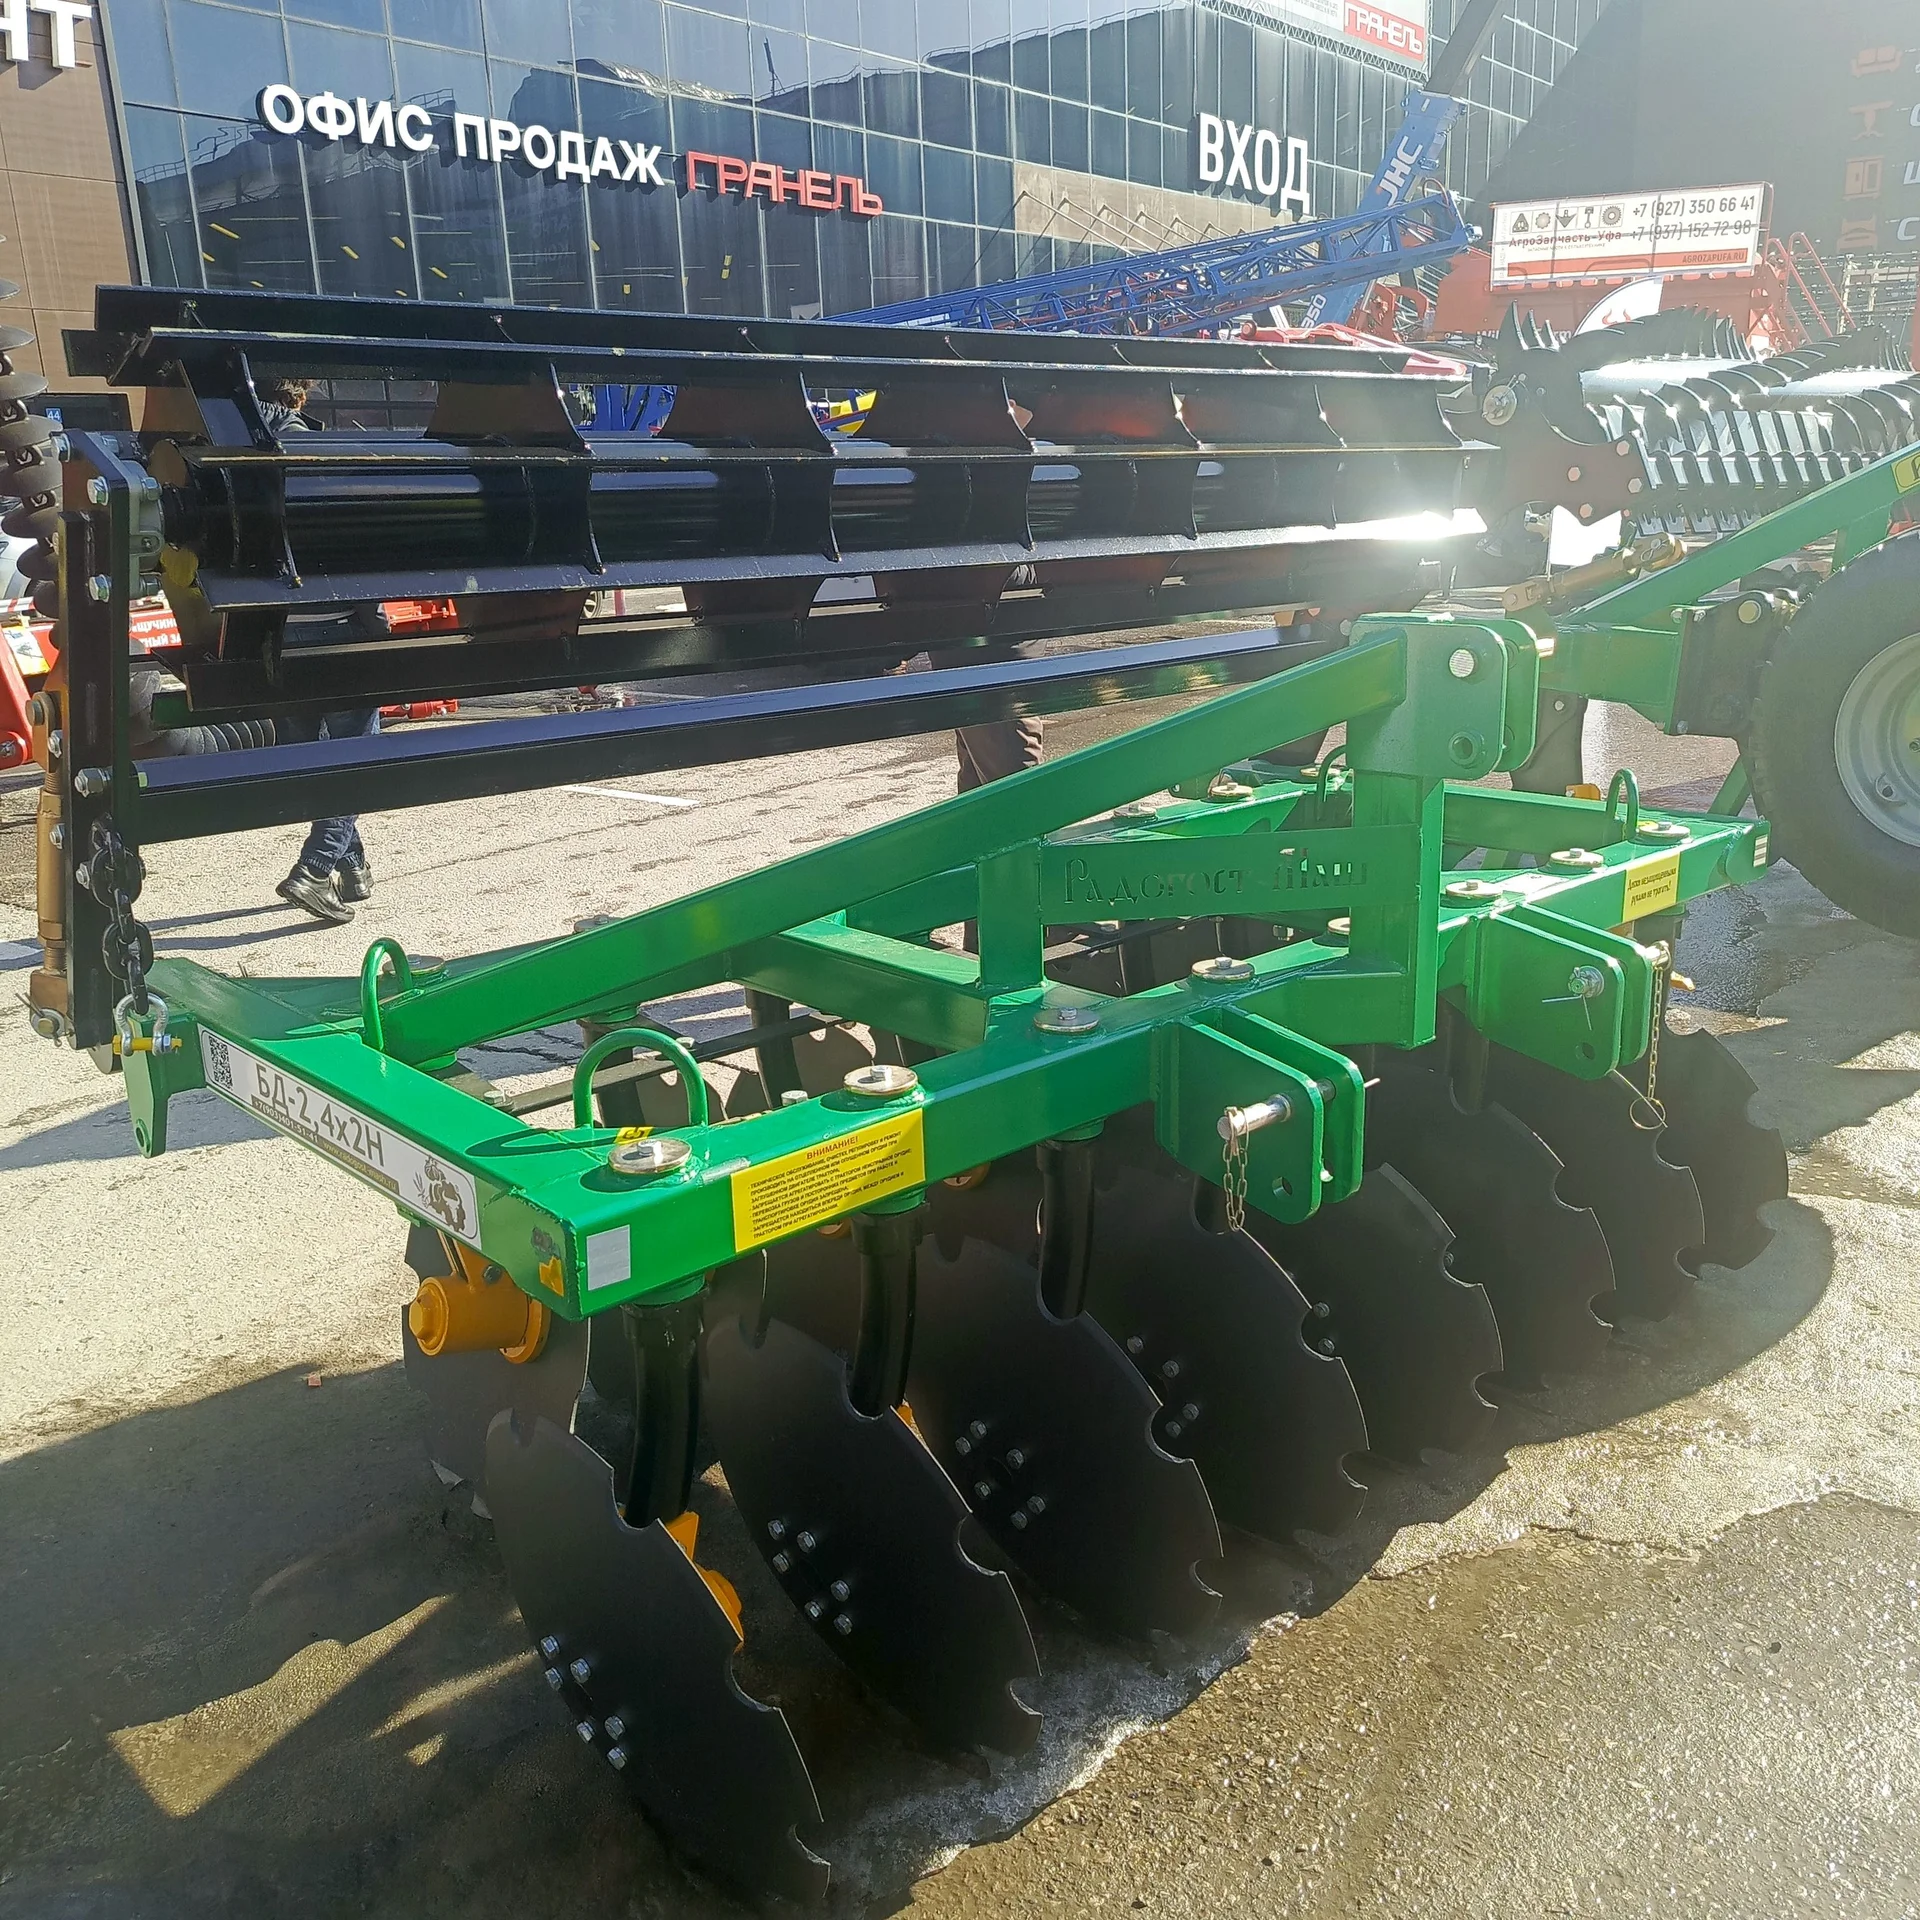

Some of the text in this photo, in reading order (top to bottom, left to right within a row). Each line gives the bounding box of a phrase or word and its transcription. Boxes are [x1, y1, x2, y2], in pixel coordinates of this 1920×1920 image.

[1344, 3, 1424, 55] ГРАНЕЛЬ
[260, 84, 665, 187] ОФИС ПРОДАЖ
[1199, 112, 1310, 214] ВХОД
[686, 151, 884, 217] ГРАНЕЛЬ
[1633, 195, 1755, 218] +7 (927) 350 66 41
[1630, 220, 1752, 242] +7 (937) 152 72 98
[1682, 252, 1745, 263] AGROZAPUFA.RU
[807, 1136, 859, 1160] ВНИМАНИЕ!
